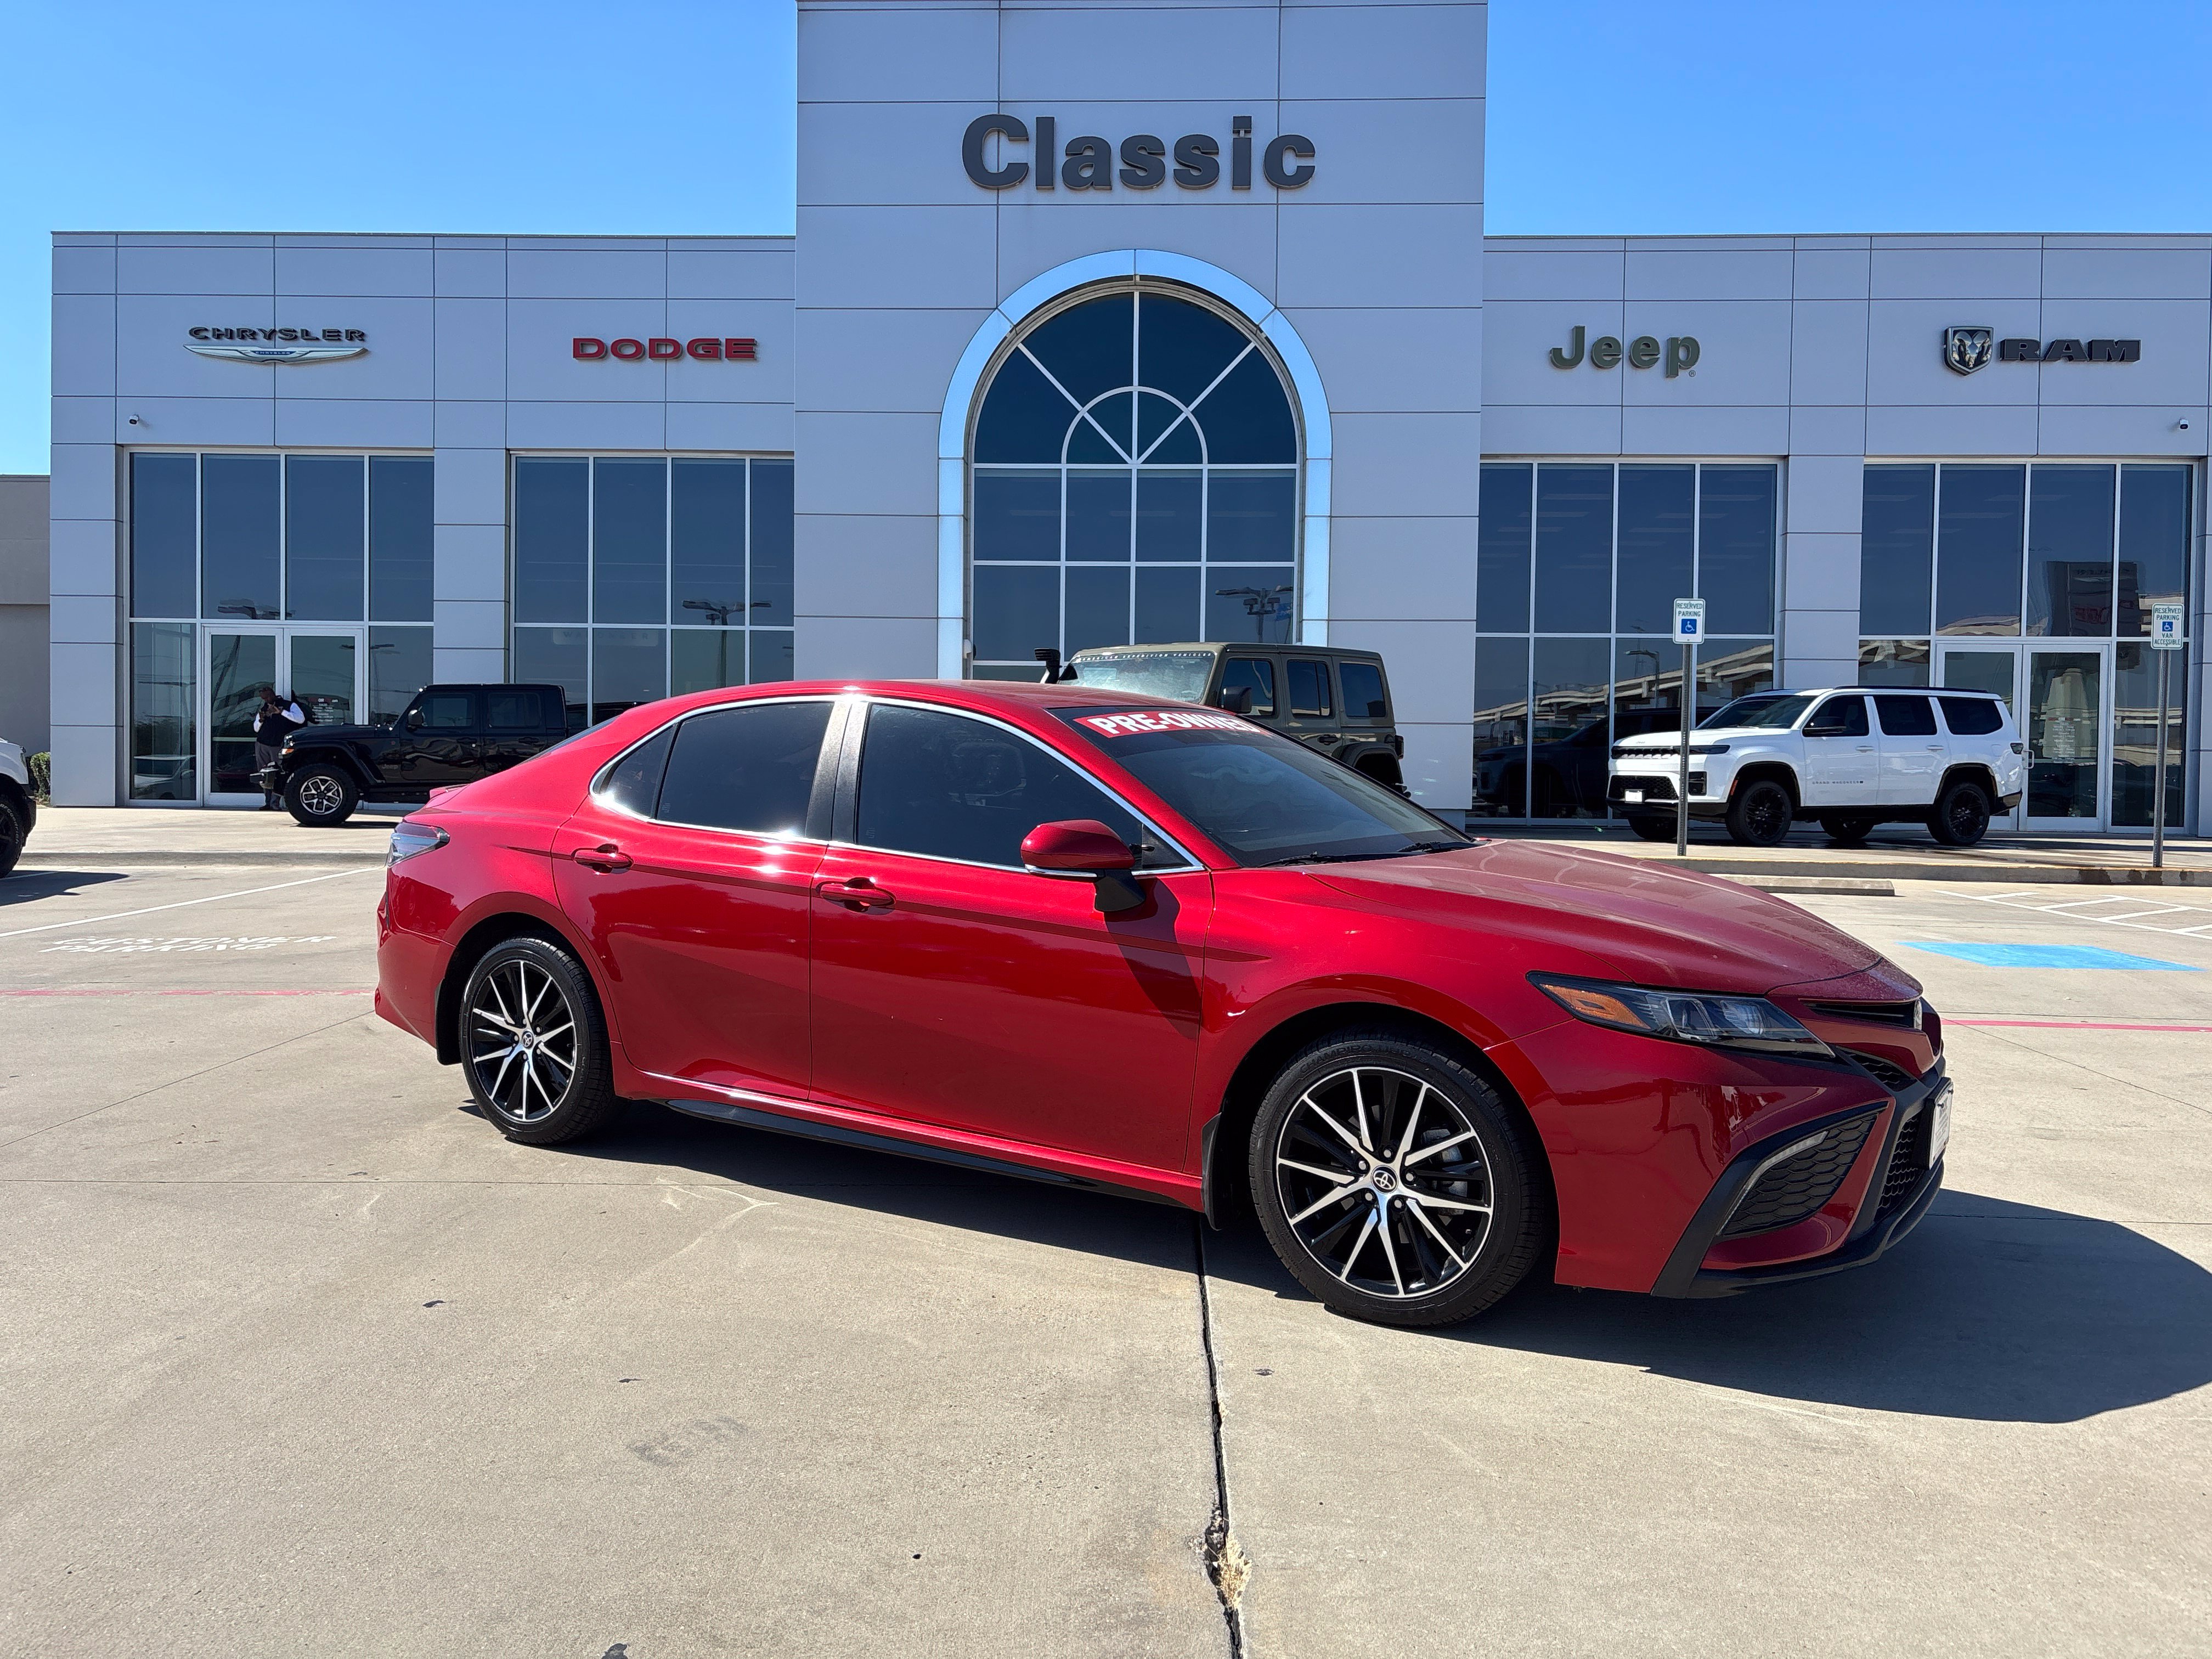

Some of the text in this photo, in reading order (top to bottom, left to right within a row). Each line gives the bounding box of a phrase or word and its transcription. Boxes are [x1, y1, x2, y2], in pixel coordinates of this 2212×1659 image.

[962, 114, 1316, 190] Classic
[188, 326, 366, 341] CHRYSLER
[573, 337, 758, 360] DODGE
[1549, 325, 1701, 378] Jeep
[2000, 338, 2141, 362] RAM
[563, 631, 648, 640] WAONEER
[1086, 713, 1261, 734] PRE-OWNED
[38, 944, 278, 952] PARKING
[52, 936, 337, 945] CUSTOMER
